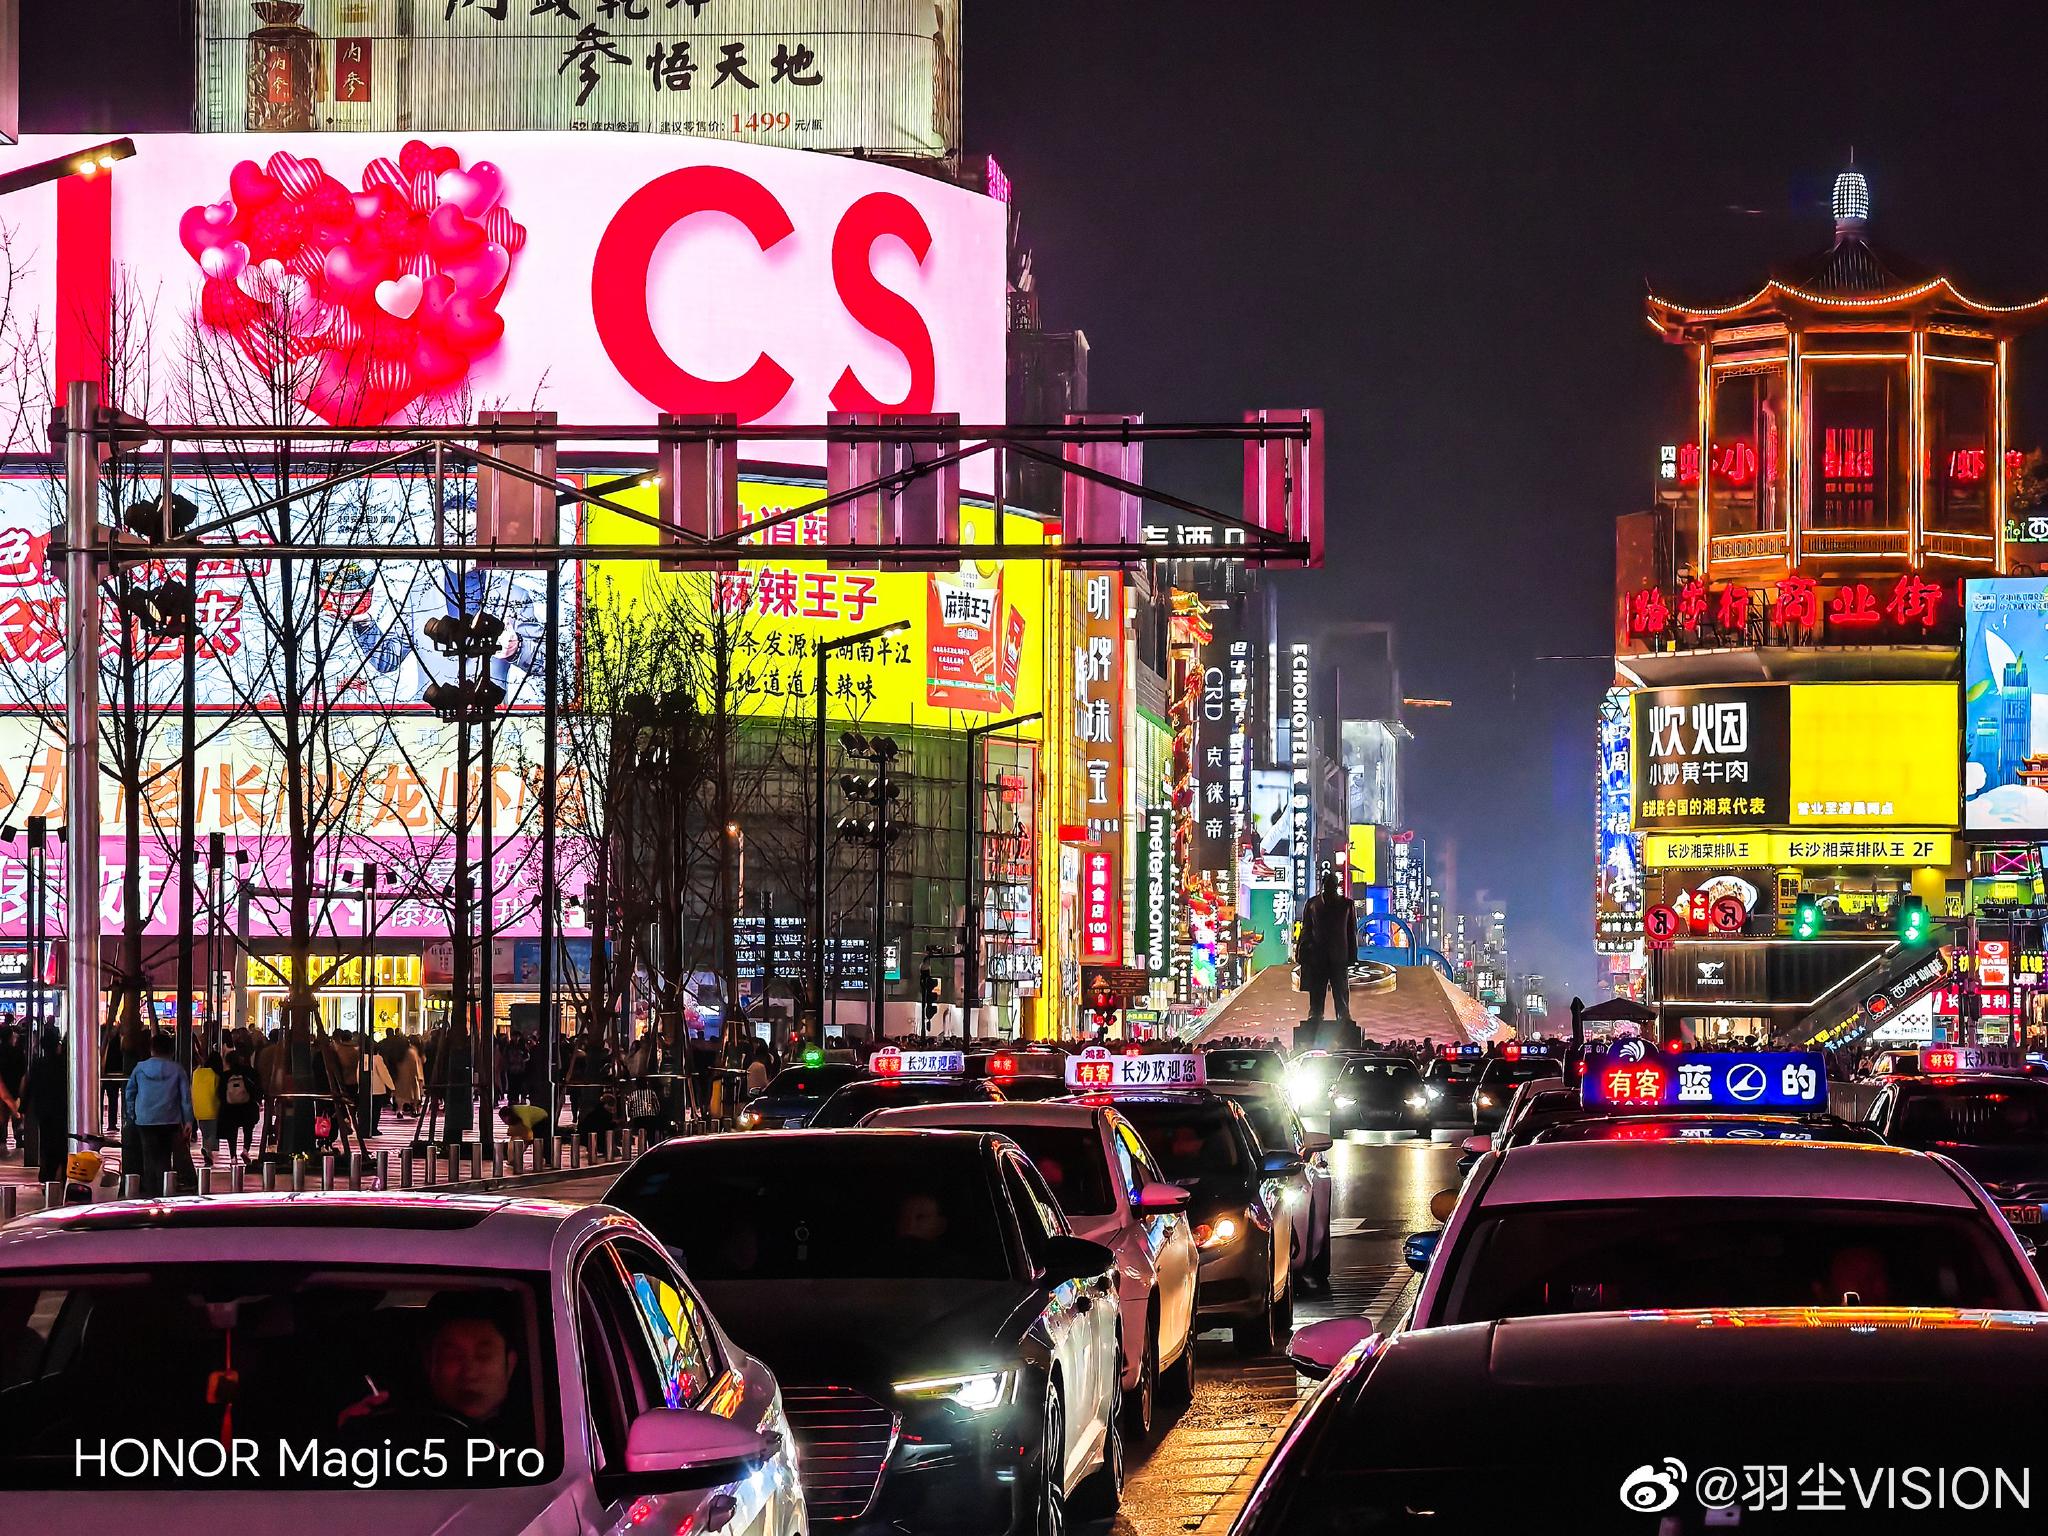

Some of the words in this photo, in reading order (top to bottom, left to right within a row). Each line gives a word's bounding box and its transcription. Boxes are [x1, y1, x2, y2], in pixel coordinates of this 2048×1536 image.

[558, 22, 823, 107] 参悟天地
[732, 112, 792, 134] 1499
[944, 590, 991, 625] 麻辣王子
[1204, 666, 1224, 722] CRD
[1649, 702, 1748, 757] 炊烟
[1649, 760, 1748, 786] 小炒黄牛肉
[1641, 797, 1766, 818] 走进联合国的湘菜代表
[1667, 842, 1749, 859] 长沙湘菜排队王
[1788, 840, 1905, 858] 长沙湘菜排队王
[1913, 841, 1935, 858] 2F
[1148, 814, 1166, 972] metersbonwe
[1080, 1064, 1111, 1082] 有客
[1121, 1060, 1197, 1083] 长沙欢迎您
[1609, 1070, 1660, 1099] 有客
[1677, 1064, 1713, 1101] 蓝
[1782, 1064, 1816, 1098] 的
